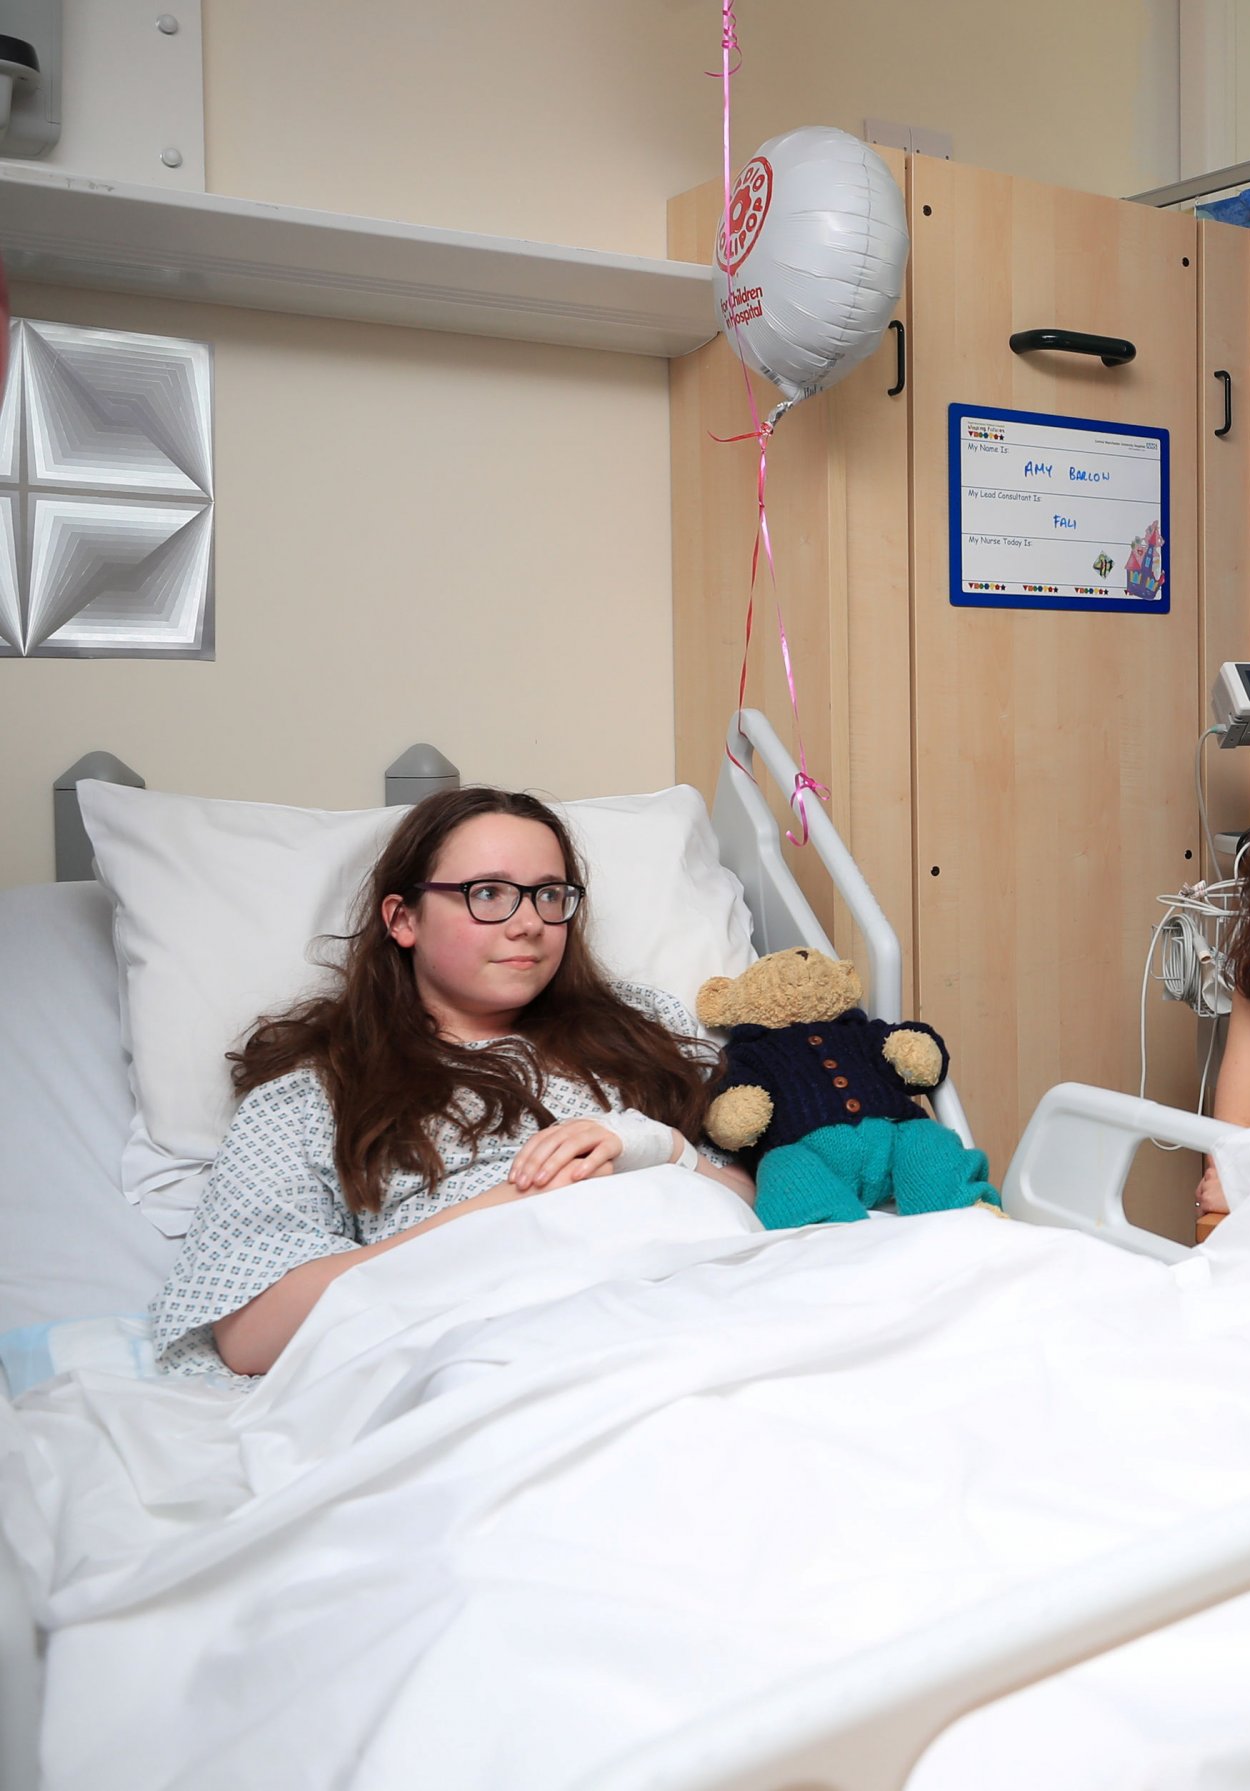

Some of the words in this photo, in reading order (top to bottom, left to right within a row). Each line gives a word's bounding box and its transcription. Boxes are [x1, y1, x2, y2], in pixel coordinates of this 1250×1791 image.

[968, 442, 978, 452] My
[980, 444, 999, 453] Name
[1024, 460, 1053, 478] AMY
[1069, 466, 1110, 482] BARLOW
[968, 489, 978, 499] My
[980, 490, 996, 499] Lead
[998, 491, 1031, 501] Consultant
[968, 536, 979, 545] My
[981, 536, 1001, 545] Nurse
[1003, 538, 1022, 548] Today
